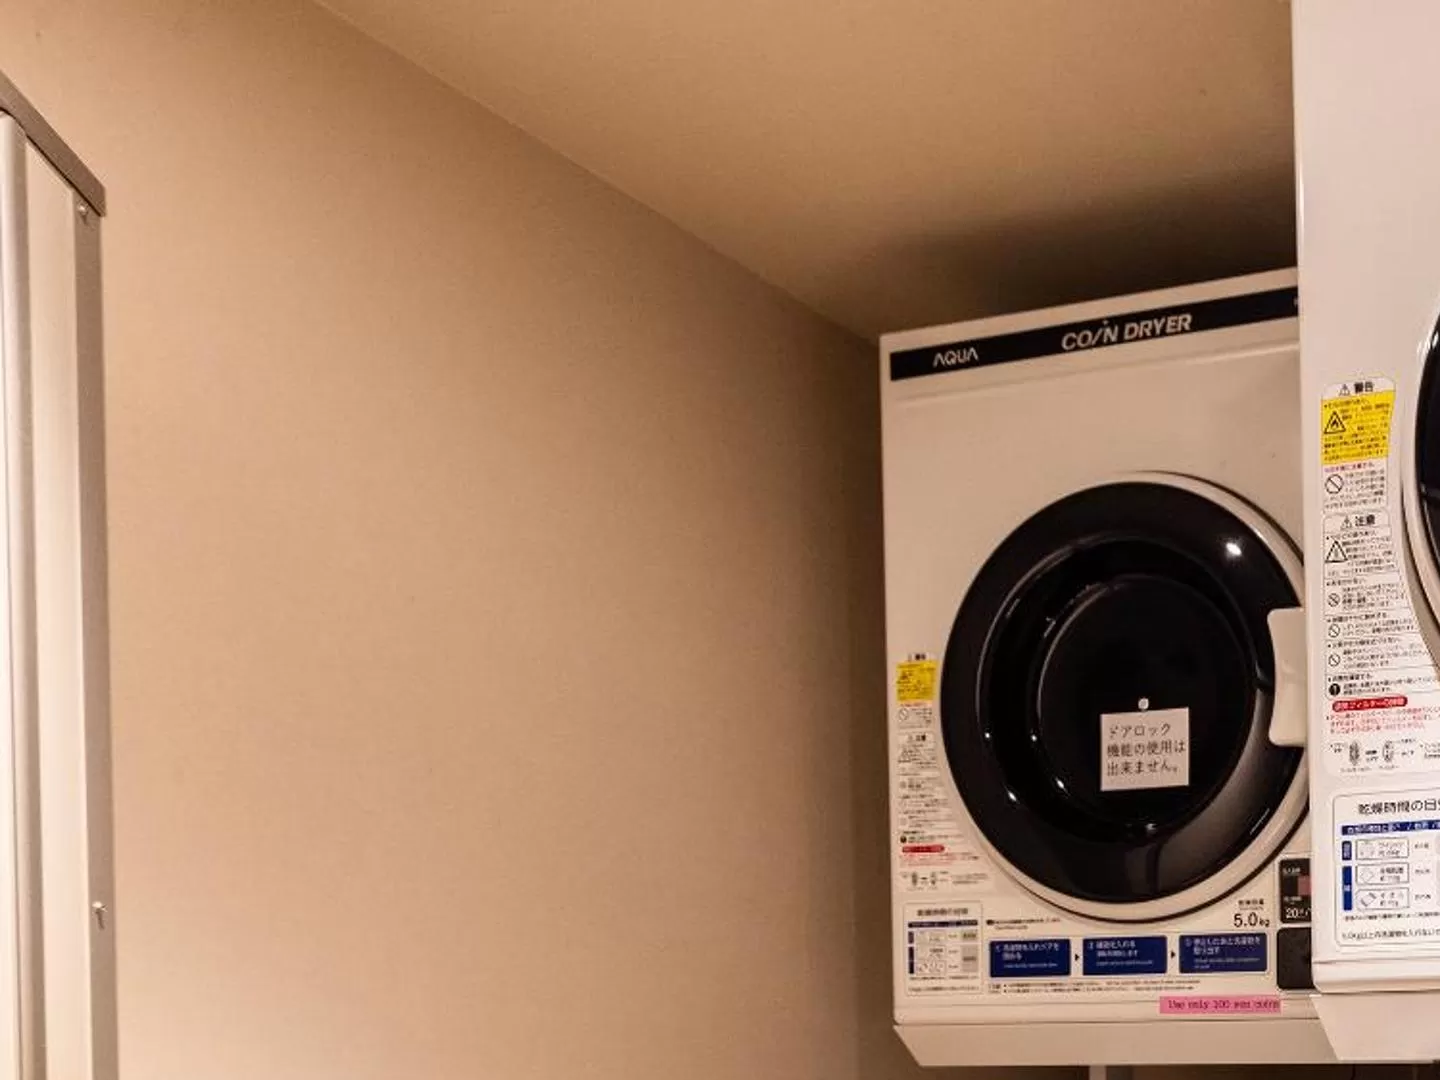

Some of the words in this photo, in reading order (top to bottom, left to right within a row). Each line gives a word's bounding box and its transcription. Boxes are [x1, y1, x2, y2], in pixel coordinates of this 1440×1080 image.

[1124, 313, 1192, 339] DRYER
[933, 347, 979, 367] AQUA
[1109, 723, 1171, 738] ドアロック
[1107, 739, 1186, 757] 機能の使用は
[1107, 760, 1178, 777] 出来ません。
